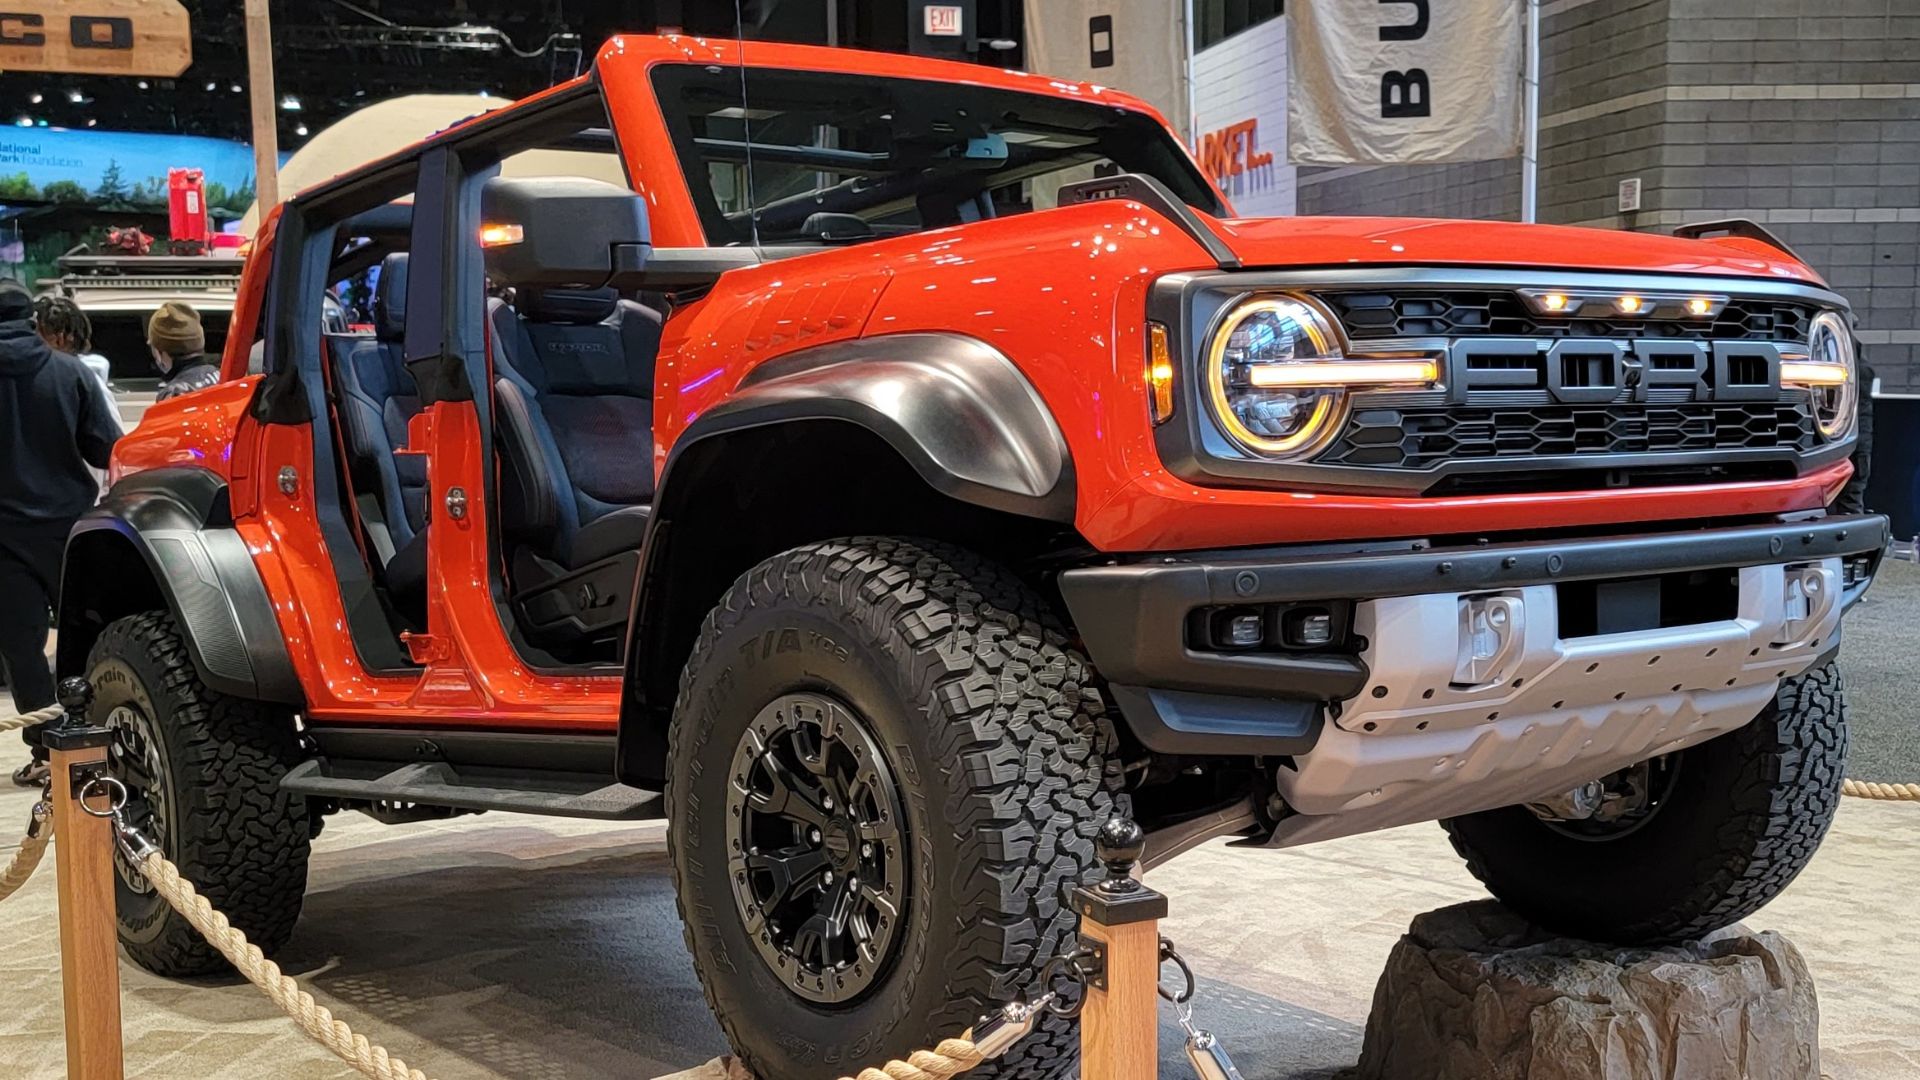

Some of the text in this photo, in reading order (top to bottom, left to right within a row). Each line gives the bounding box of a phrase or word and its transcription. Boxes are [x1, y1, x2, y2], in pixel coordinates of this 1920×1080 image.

[930, 8, 955, 27] EXIT
[1452, 339, 1781, 403] FORD
[739, 627, 802, 668] T/A
